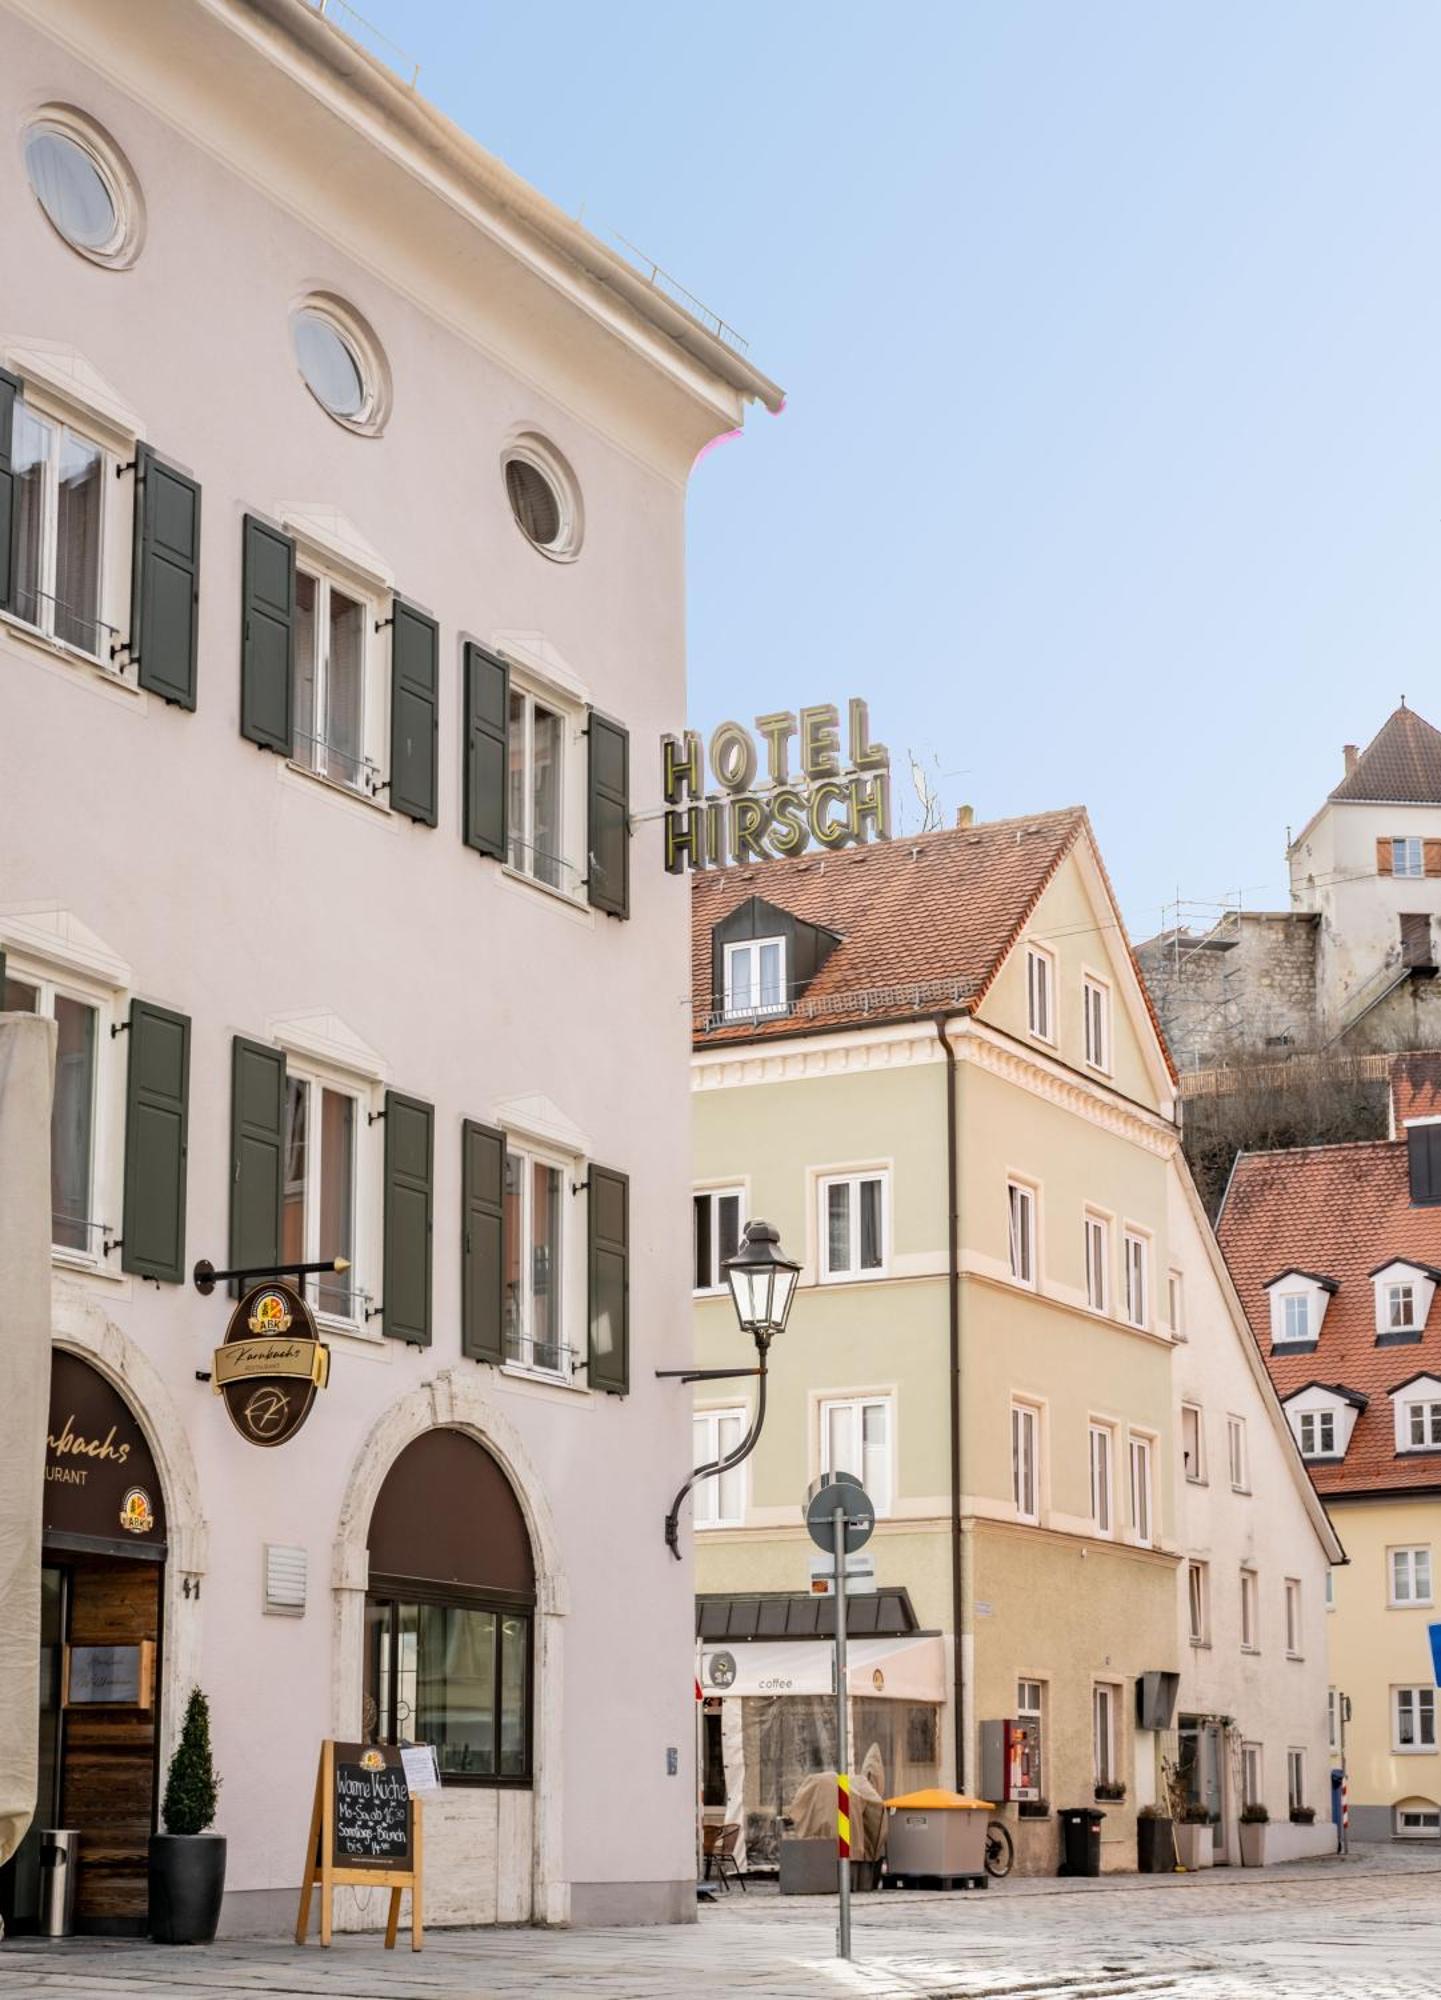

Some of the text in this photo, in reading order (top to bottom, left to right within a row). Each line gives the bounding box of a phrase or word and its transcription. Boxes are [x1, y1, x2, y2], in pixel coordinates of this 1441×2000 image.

[660, 698, 889, 804] HOTEL
[664, 774, 891, 875] HIRSCH
[260, 1319, 281, 1330] ABK
[47, 1414, 130, 1463] nbachs
[45, 1466, 88, 1485] URANT
[758, 1678, 793, 1689] coffee
[336, 1770, 371, 1797] Warme
[370, 1806, 382, 1821] ab
[346, 1837, 363, 1853] bis
